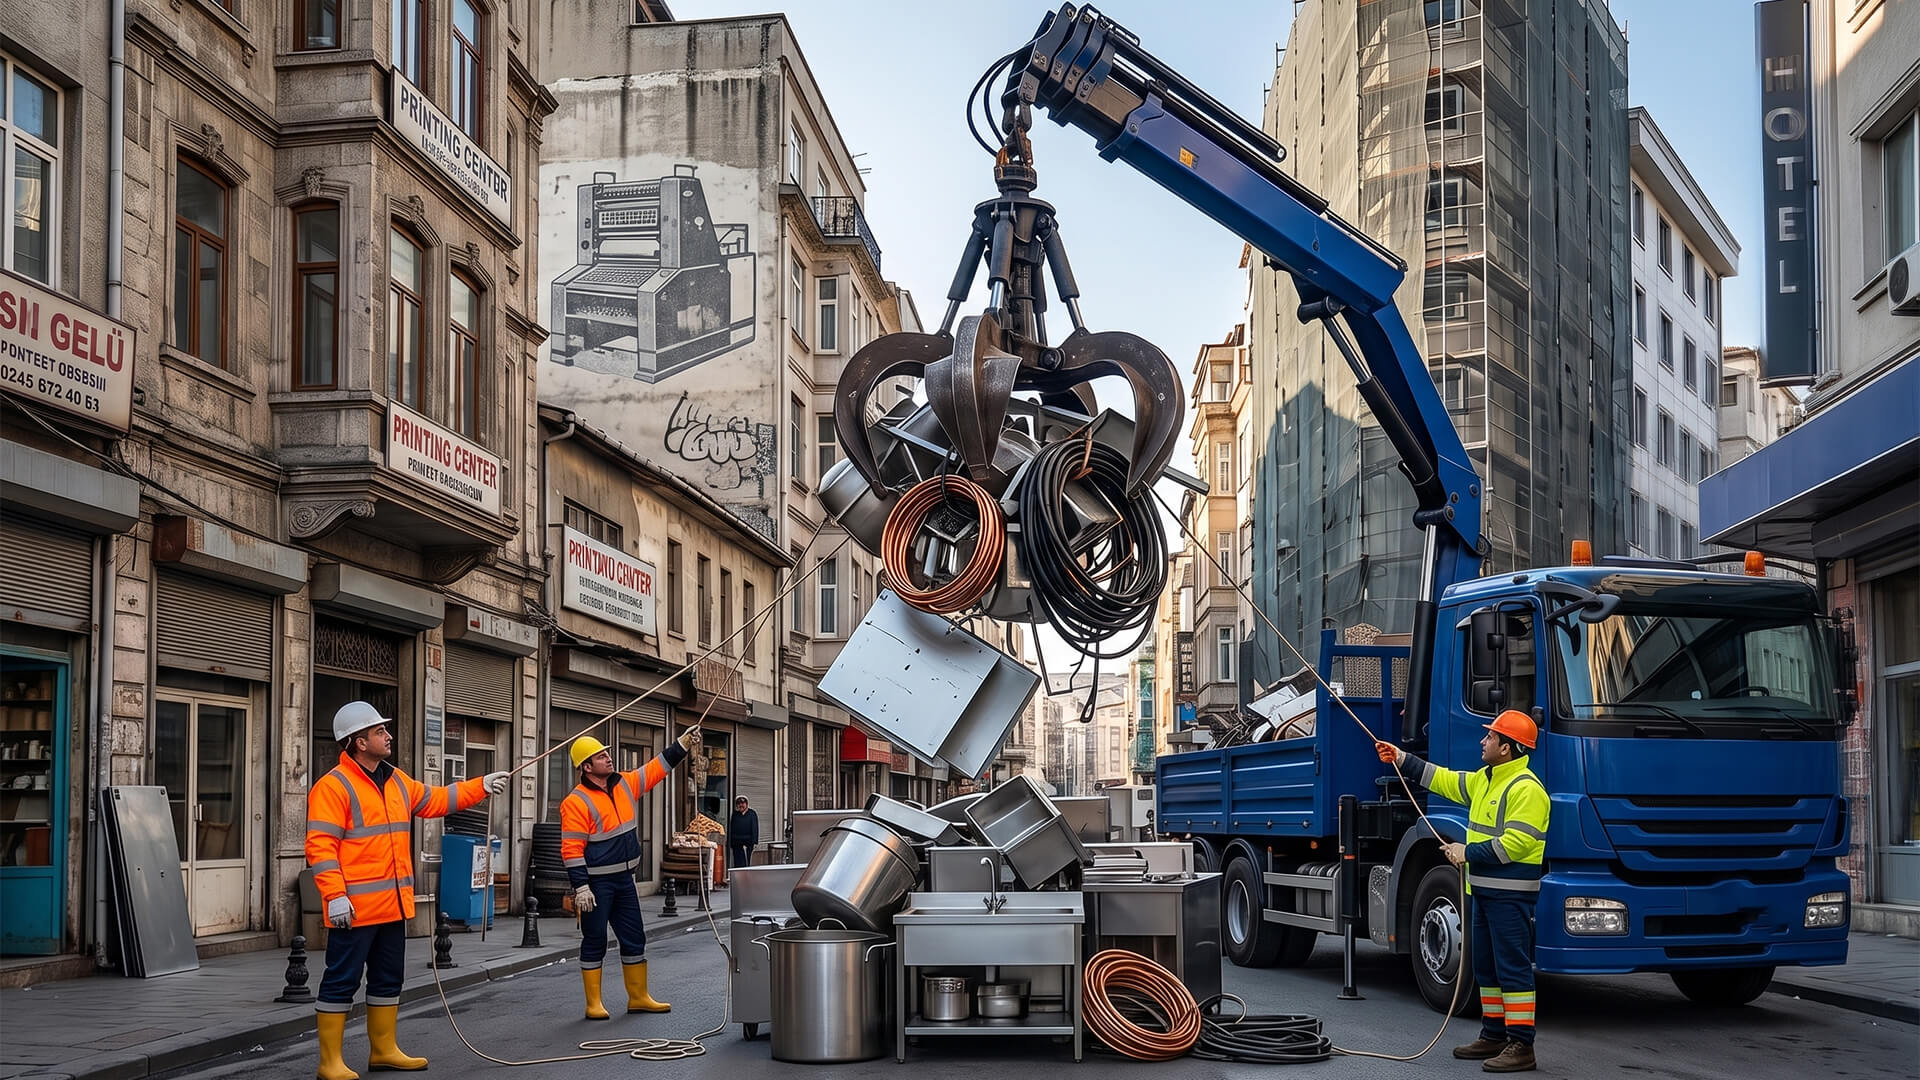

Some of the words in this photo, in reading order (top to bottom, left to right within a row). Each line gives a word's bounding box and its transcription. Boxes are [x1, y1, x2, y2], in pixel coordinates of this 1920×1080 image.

[1764, 55, 1806, 293] HOTEL
[50, 313, 124, 372] GELÜ
[1, 364, 34, 389] 0245
[38, 378, 62, 399] 672
[65, 388, 82, 406] 40
[393, 414, 451, 467] PRINTING
[454, 445, 497, 490] CENTER
